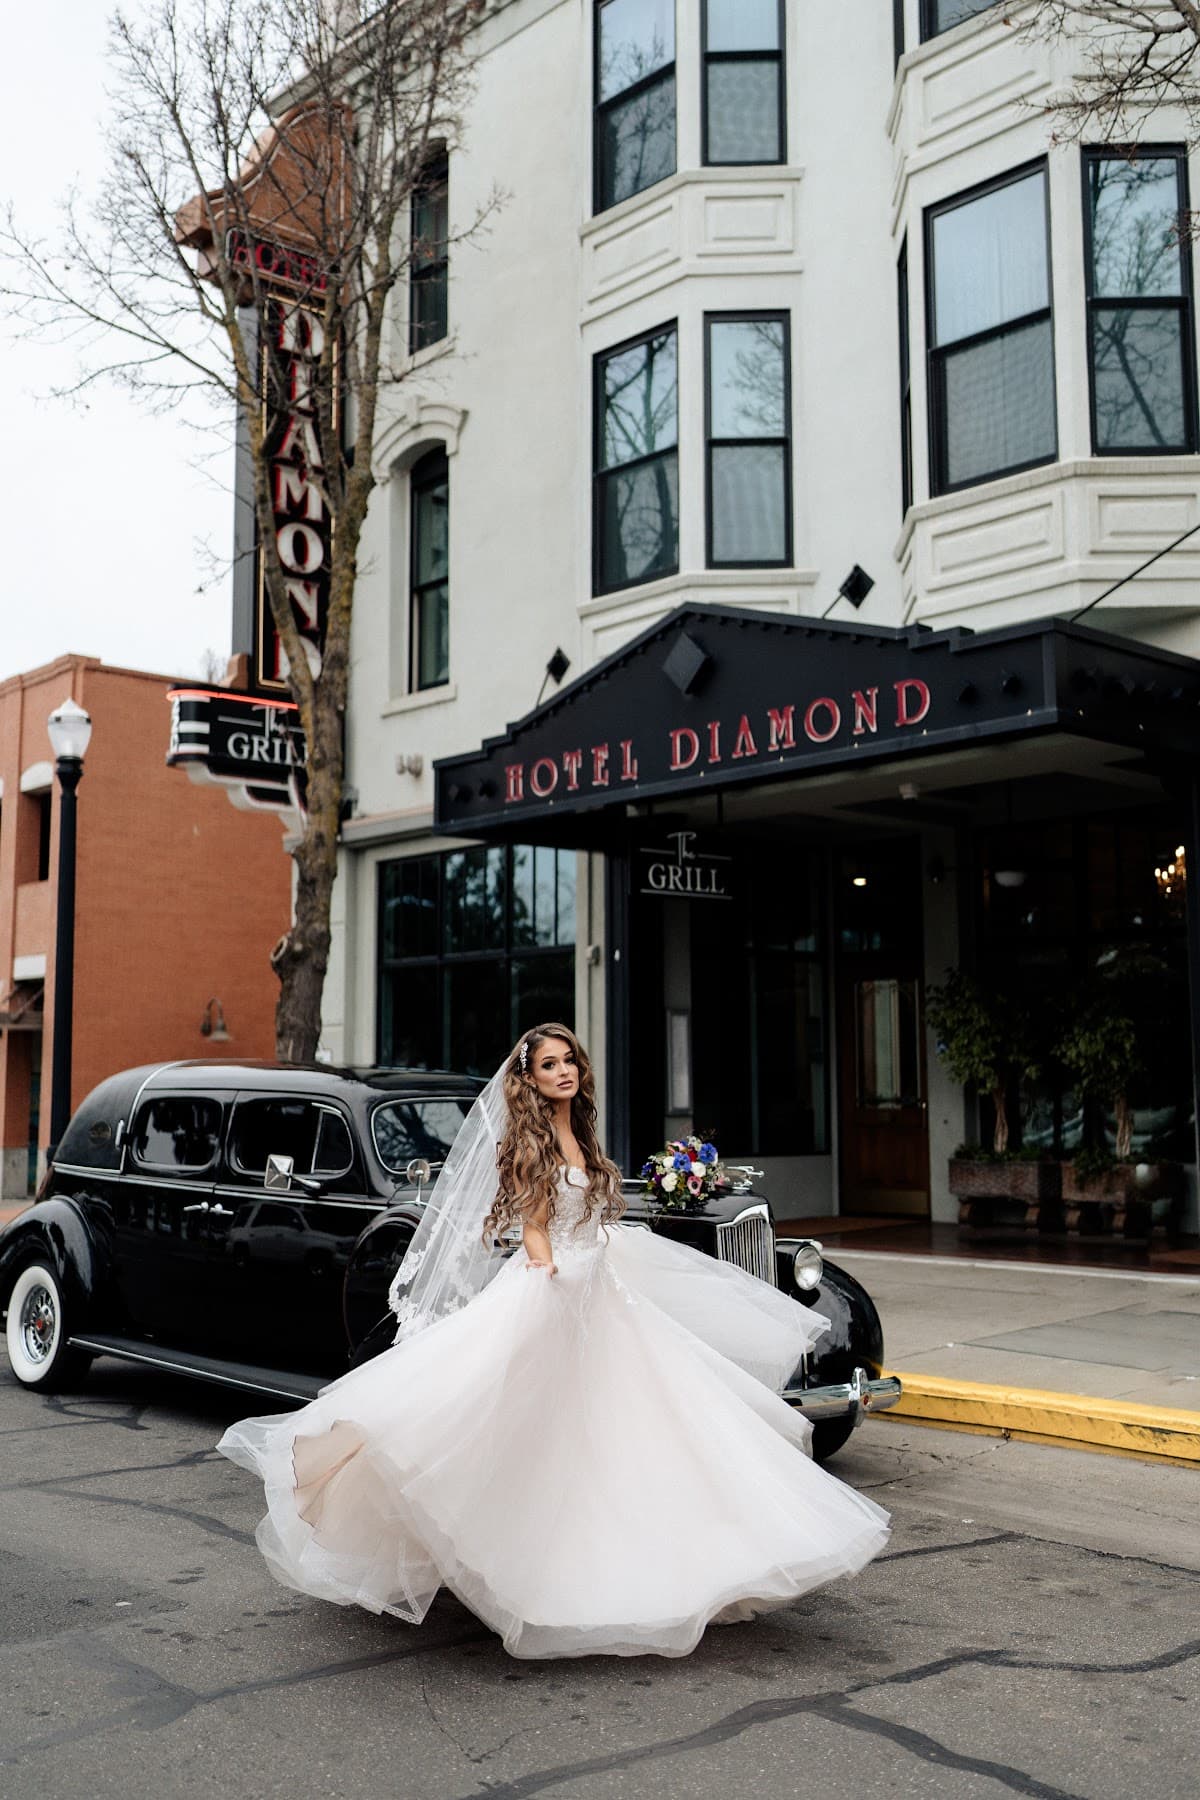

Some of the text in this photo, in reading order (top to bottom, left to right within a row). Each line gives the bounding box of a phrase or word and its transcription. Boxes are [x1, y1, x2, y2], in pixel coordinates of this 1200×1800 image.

[504, 678, 931, 801] HOTEL DIAMOND
[667, 831, 697, 866] The
[648, 863, 725, 894] GRILL
